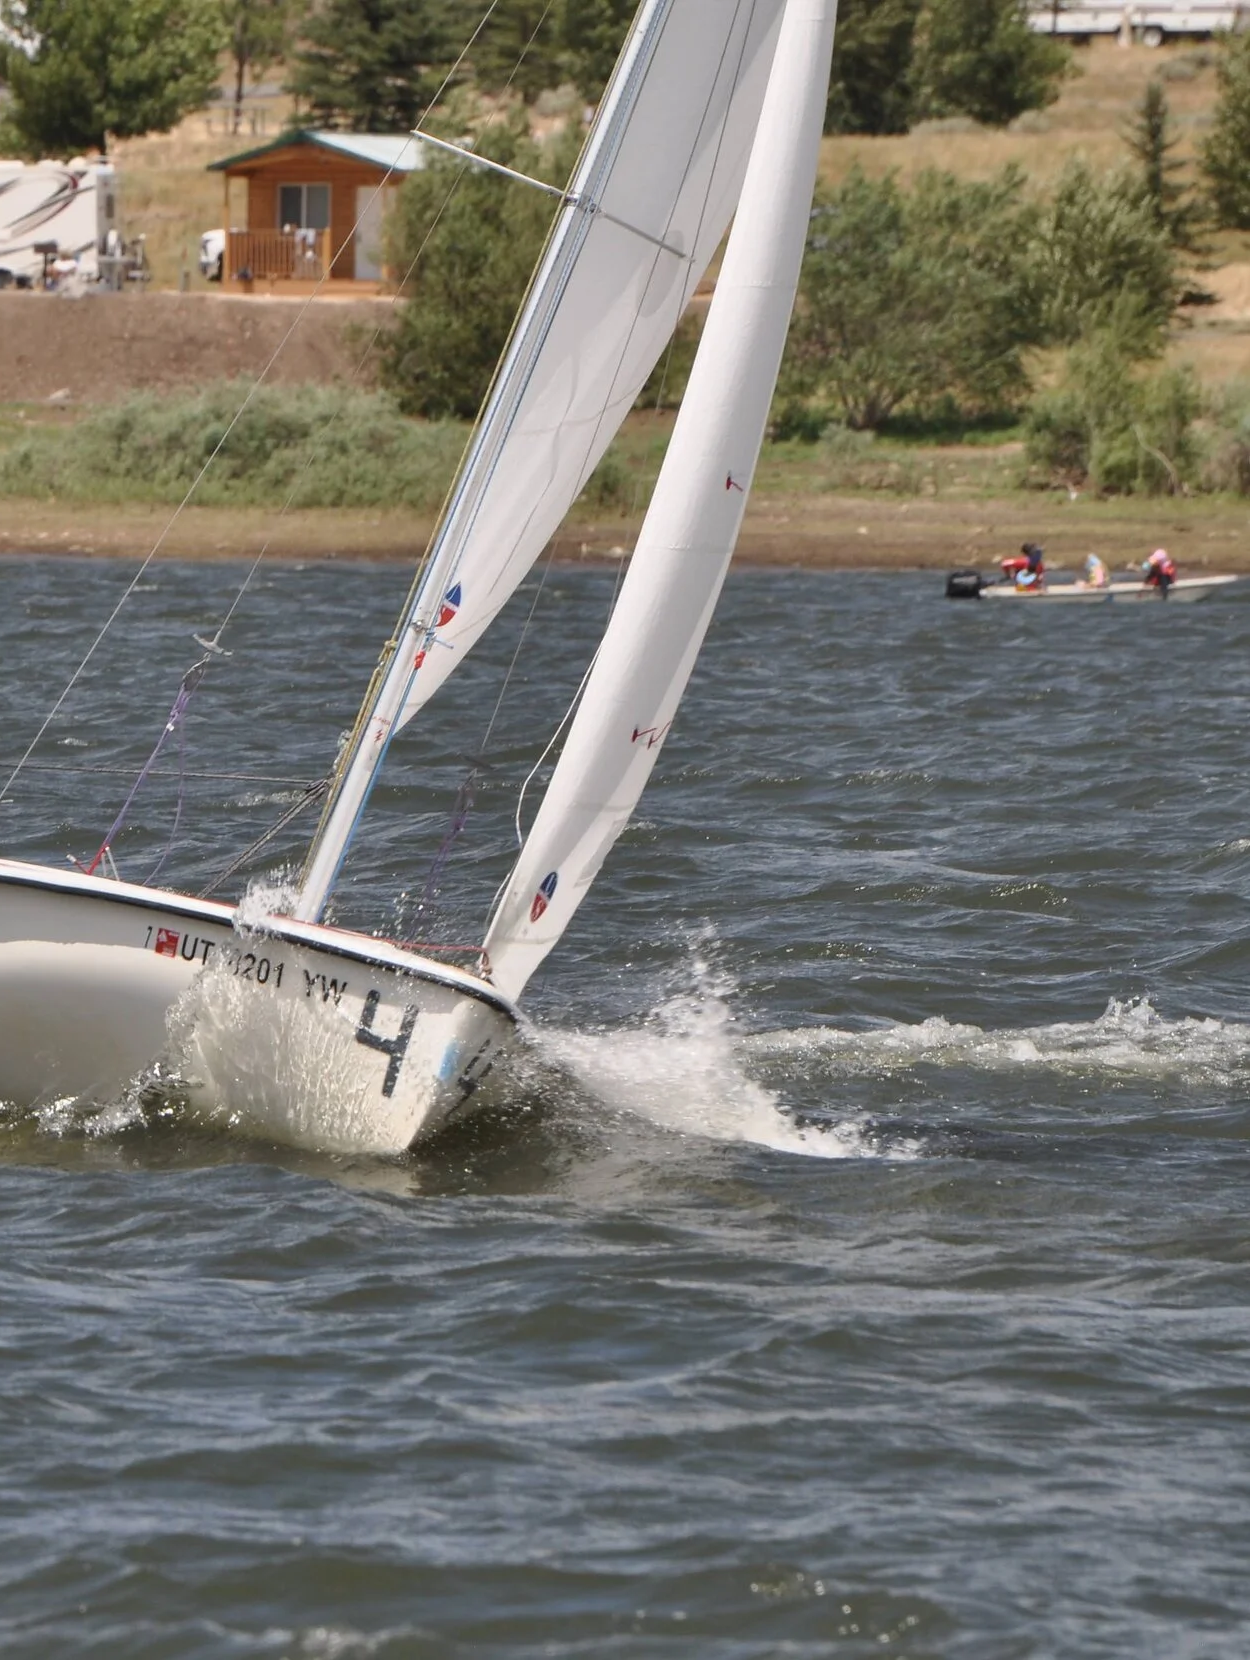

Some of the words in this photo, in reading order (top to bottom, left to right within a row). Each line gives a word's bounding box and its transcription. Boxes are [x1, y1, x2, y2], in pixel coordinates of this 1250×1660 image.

[181, 933, 216, 966] UT
[303, 968, 348, 1006] YW
[355, 988, 420, 1099] 4
